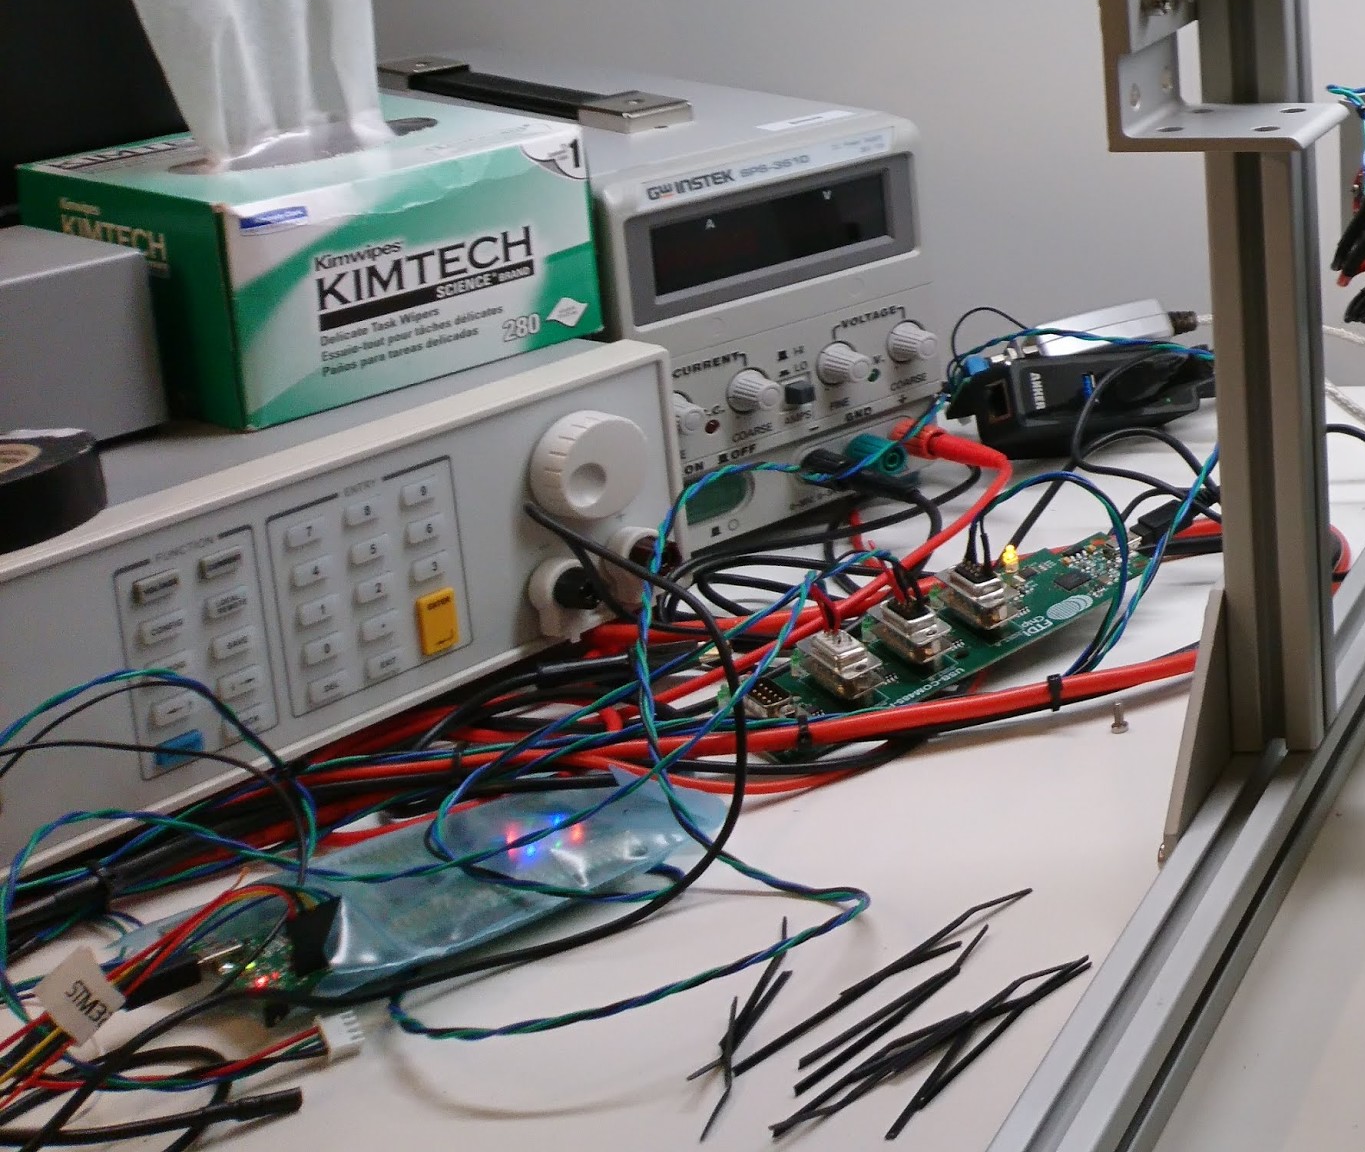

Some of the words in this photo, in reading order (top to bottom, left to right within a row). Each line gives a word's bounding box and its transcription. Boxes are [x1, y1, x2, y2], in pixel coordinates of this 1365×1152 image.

[568, 138, 580, 169] 1
[704, 218, 716, 230] A
[314, 241, 401, 272] Kimwipes
[316, 225, 532, 311] KIMTECH
[436, 274, 492, 298] SCIENCE
[498, 266, 531, 281] BRAND
[320, 326, 368, 347] Delicate
[371, 318, 397, 334] Task
[400, 307, 440, 325] Wipers
[840, 305, 897, 329] VOLTAGE
[502, 313, 541, 343] 280
[321, 337, 384, 362] Essuie-tout
[387, 331, 411, 347] pour
[360, 353, 385, 369] para
[388, 342, 423, 360] tareas
[425, 327, 479, 349] delicadas
[672, 350, 740, 379] CURRENT
[890, 371, 929, 392] COARSE
[1029, 372, 1046, 410] ANKER
[784, 409, 813, 426] AMPS
[845, 406, 873, 422] GND
[731, 422, 774, 444] COARSE
[731, 444, 758, 460] OFF
[684, 462, 704, 475] ON
[419, 485, 427, 497] 9
[305, 525, 313, 537] 7
[425, 523, 434, 534] 6
[155, 536, 214, 561] FUNCTION
[369, 543, 377, 555] 5
[311, 565, 320, 576] 4
[430, 560, 438, 571] 3
[374, 582, 382, 593] 2
[1020, 614, 1046, 631] Chip
[1021, 618, 1054, 638] FTDI
